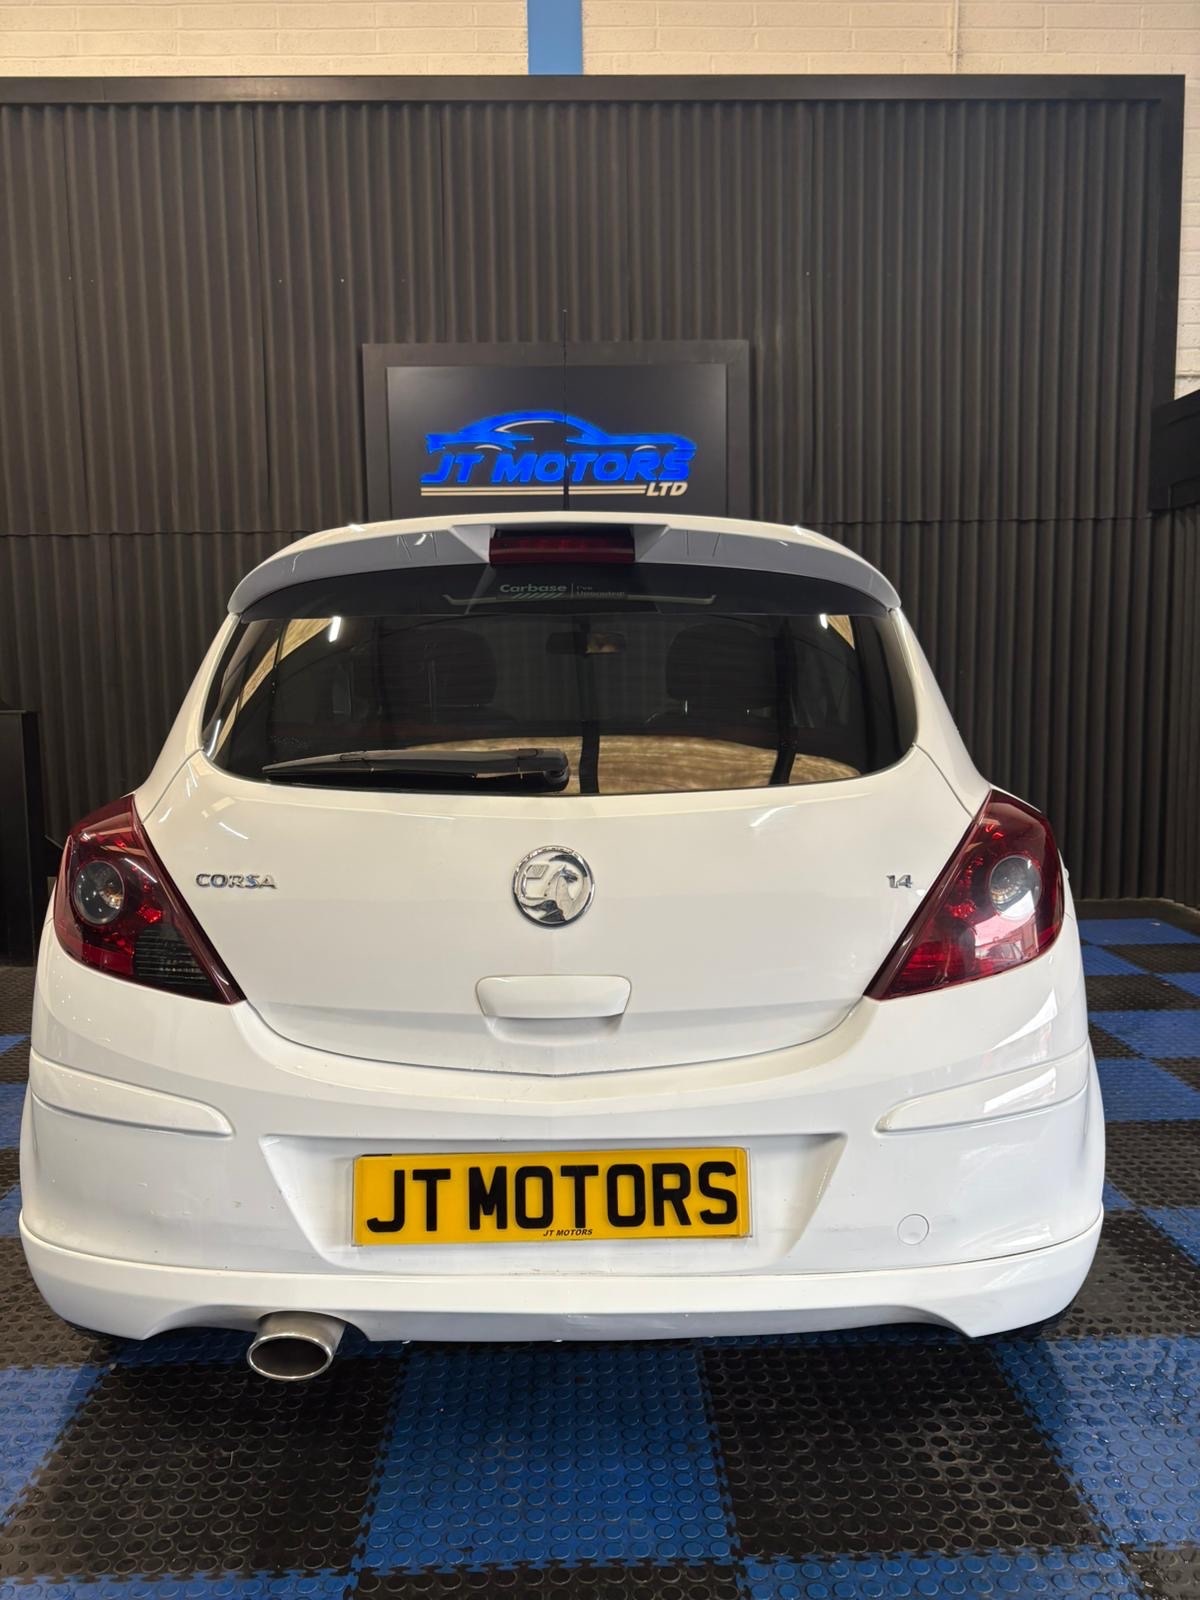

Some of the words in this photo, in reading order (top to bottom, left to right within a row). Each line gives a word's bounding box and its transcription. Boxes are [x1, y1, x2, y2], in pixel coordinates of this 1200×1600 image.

[420, 453, 486, 484] JT
[491, 451, 697, 484] MOTORS
[645, 481, 689, 497] LTD
[500, 584, 568, 593] Carbase
[195, 873, 277, 889] CORSA
[366, 1168, 451, 1233] JT
[468, 1160, 739, 1231] MOTORS
[543, 1229, 555, 1237] JT
[556, 1228, 593, 1237] MOTORS
